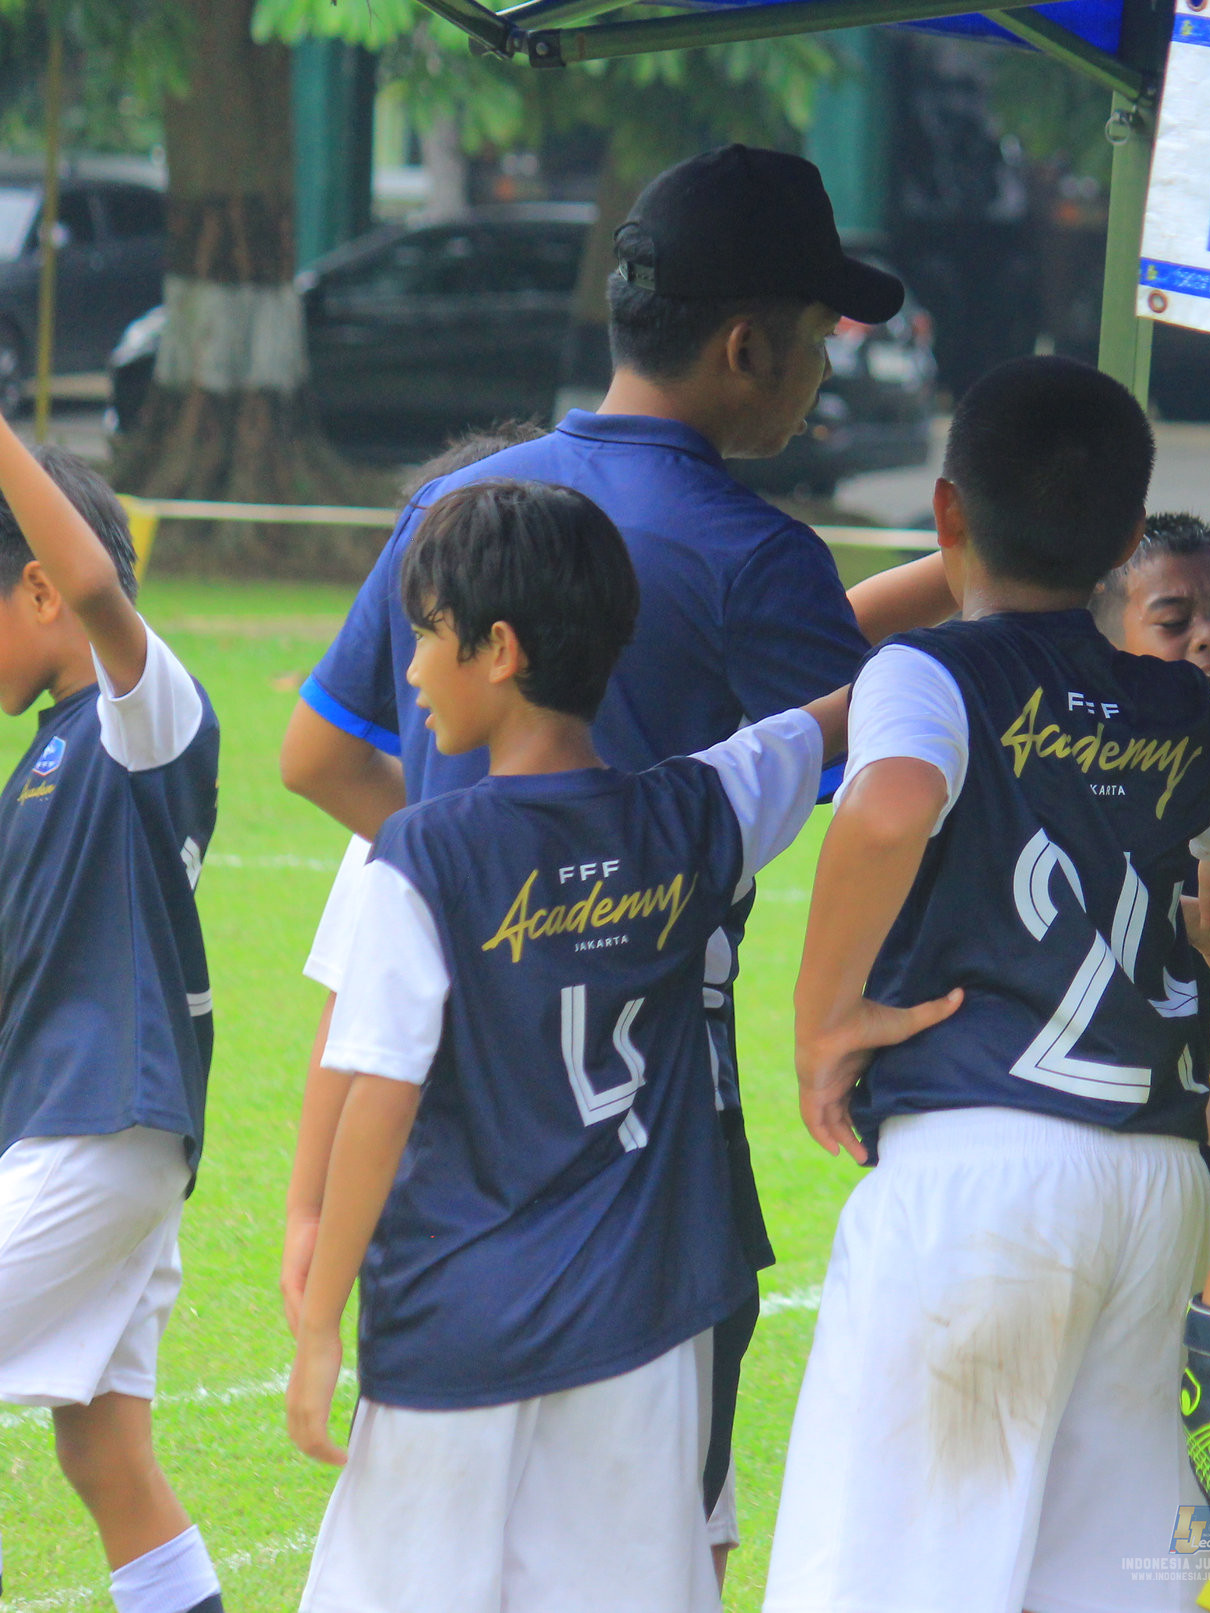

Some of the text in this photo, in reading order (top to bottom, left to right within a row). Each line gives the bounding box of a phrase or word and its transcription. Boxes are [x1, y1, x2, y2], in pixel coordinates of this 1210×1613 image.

[1000, 686, 1203, 820] Academy
[1089, 784, 1126, 796] KARTA
[559, 860, 620, 884] FFF
[482, 869, 698, 963] Academy
[575, 934, 629, 952] JAKARTA
[561, 984, 648, 1153] 4
